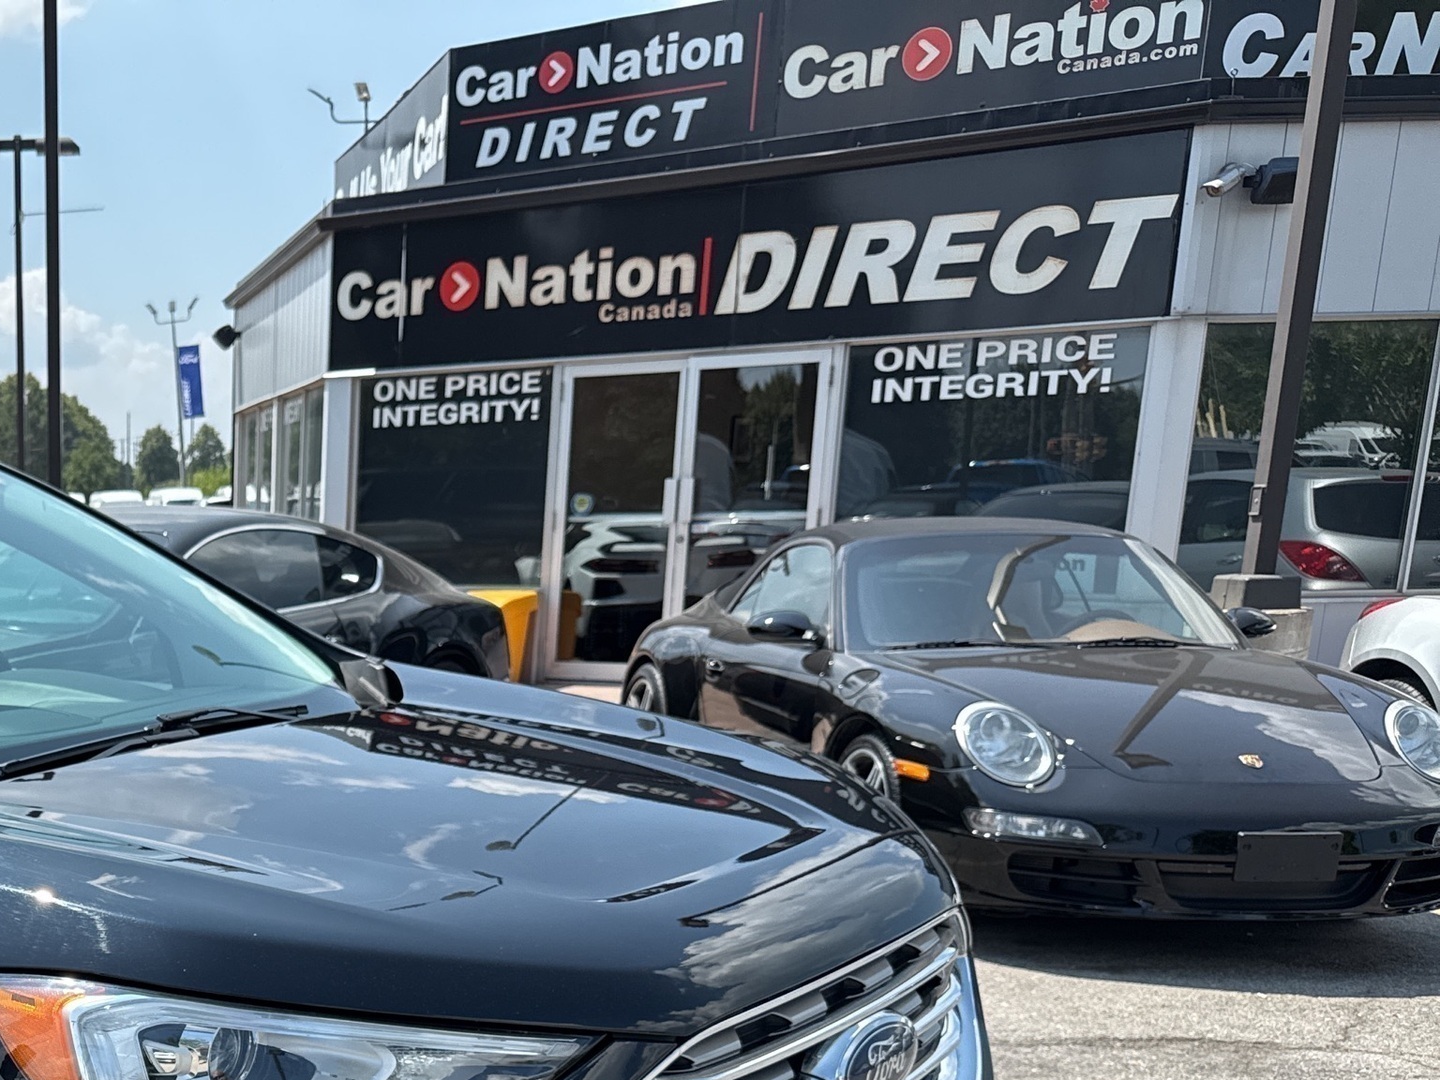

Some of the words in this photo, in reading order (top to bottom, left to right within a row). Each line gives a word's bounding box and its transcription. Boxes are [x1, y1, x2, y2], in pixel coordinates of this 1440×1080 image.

[783, 44, 900, 99] Car
[956, 0, 1204, 75] Nation
[1057, 42, 1199, 75] Canada.com
[455, 65, 537, 107] Car
[576, 31, 744, 88] Nation
[475, 97, 707, 168] DIRECT
[336, 271, 436, 321] Car
[484, 246, 697, 310] Nation
[713, 194, 1180, 315] DIRECT
[598, 299, 693, 323] Canada
[874, 344, 965, 373] ONE
[976, 333, 1118, 367] PRICE
[372, 376, 438, 402] ONE
[444, 370, 543, 399] PRICE
[871, 367, 1113, 404] INTEGRITY!
[372, 397, 541, 429] INTEGRITY!
